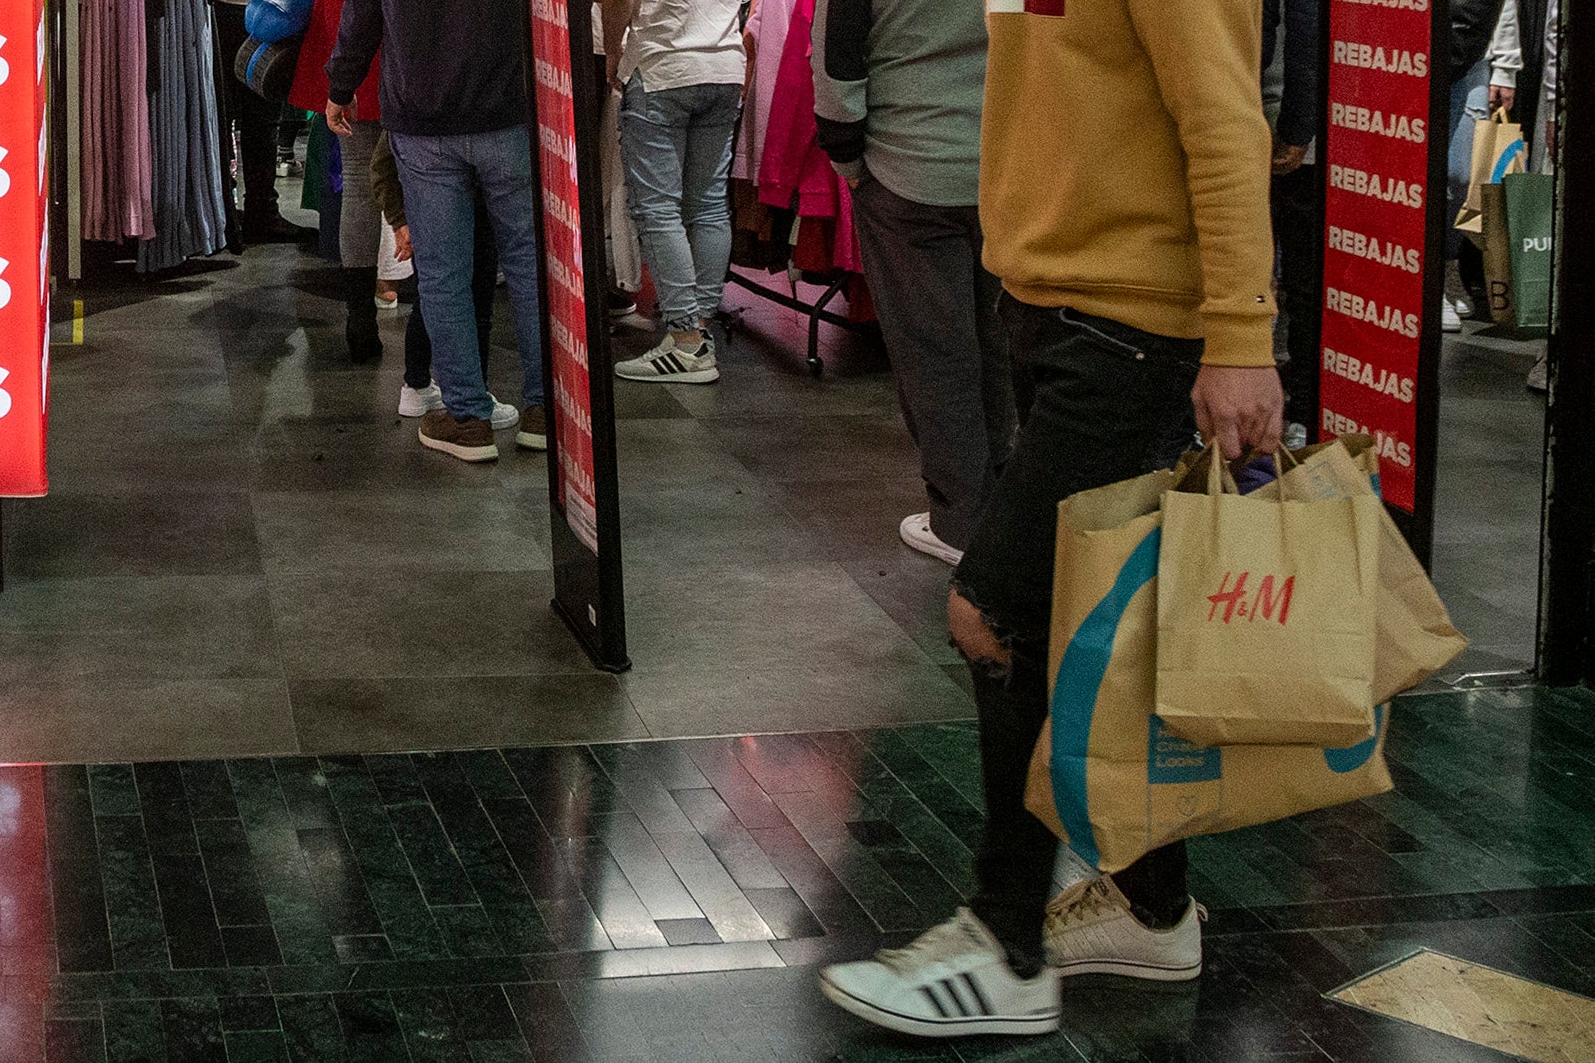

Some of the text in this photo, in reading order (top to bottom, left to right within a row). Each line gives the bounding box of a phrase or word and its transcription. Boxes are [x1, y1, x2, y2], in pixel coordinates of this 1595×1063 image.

[535, 58, 573, 98] REBAJA
[1333, 40, 1428, 78] REBAJAS
[539, 123, 577, 164] REBAJ
[1331, 102, 1426, 144] REBAJAS
[1329, 163, 1424, 209] REBAJAS
[543, 188, 581, 234] REBAJA
[1328, 225, 1421, 275] REBAJAS
[1325, 286, 1419, 339] REBAJAS
[551, 314, 589, 371] REBAJA
[1323, 346, 1415, 404] REBAJAS
[1207, 571, 1295, 626] H&M
